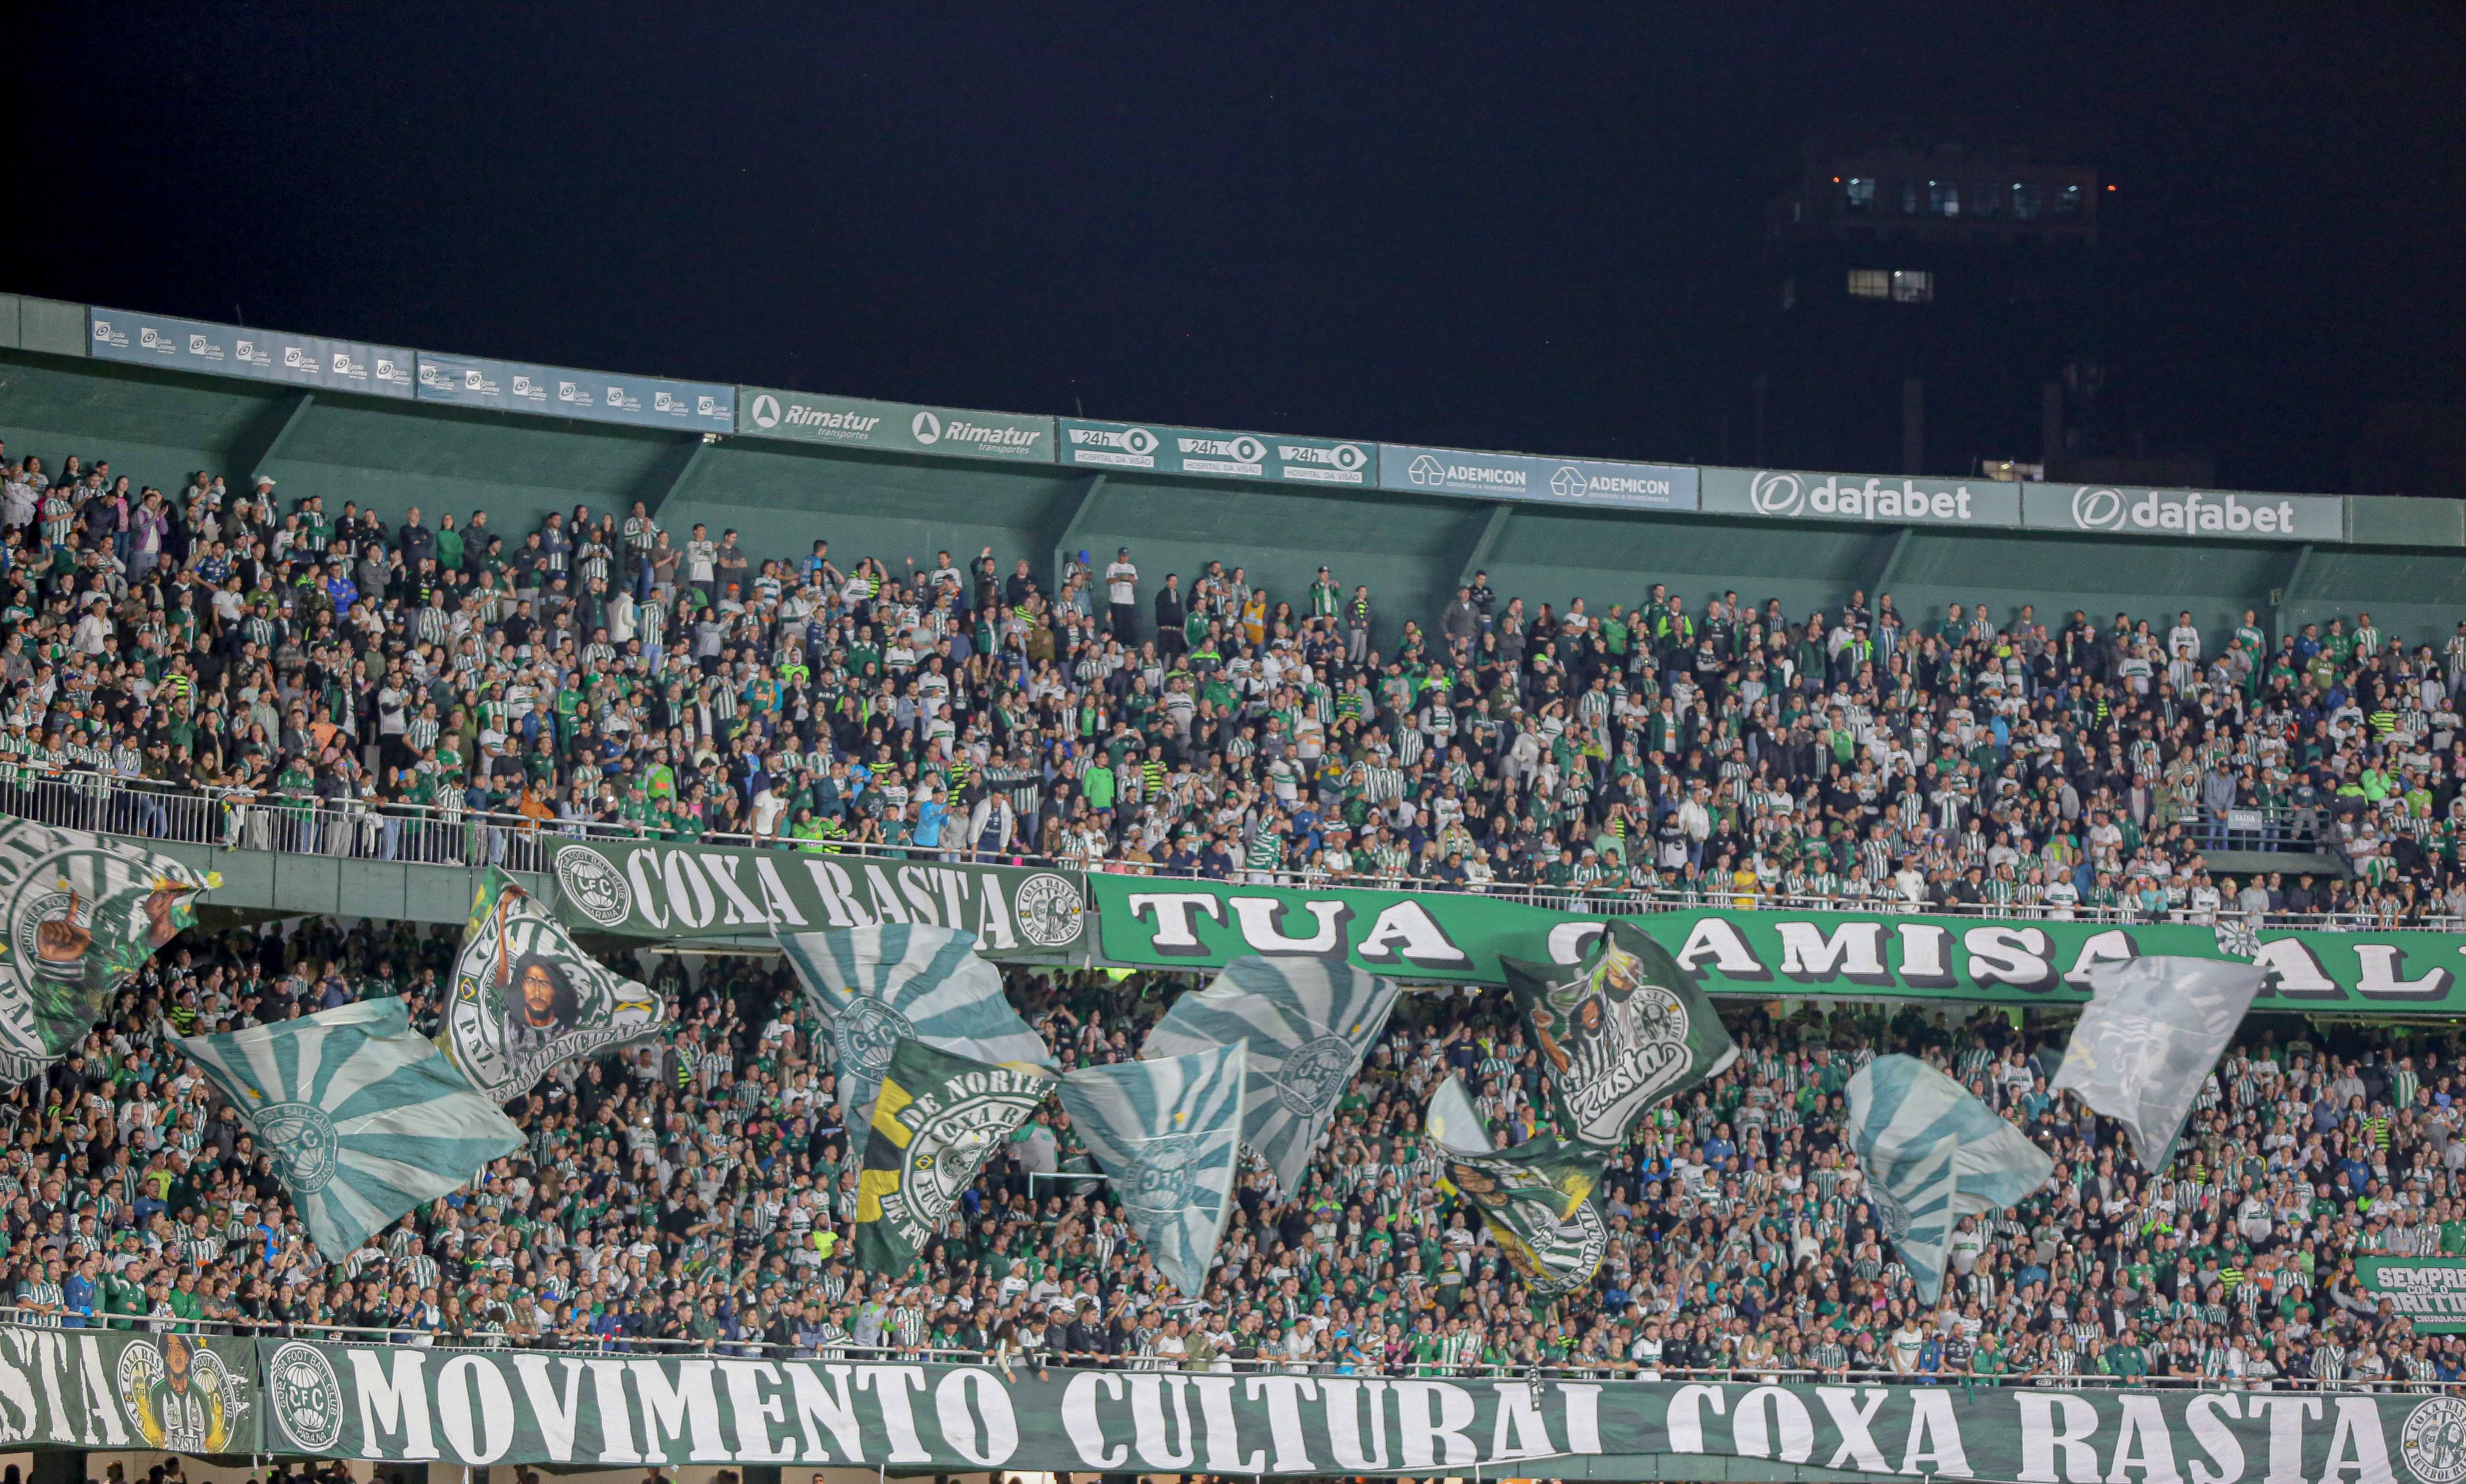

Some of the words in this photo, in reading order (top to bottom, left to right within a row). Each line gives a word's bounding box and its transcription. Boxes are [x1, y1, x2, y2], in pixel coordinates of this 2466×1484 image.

[784, 404, 880, 431] Rimatur
[818, 427, 869, 440] transportes
[945, 422, 1040, 446] Rimatur
[1082, 431, 1110, 445] 24h
[979, 443, 1030, 455] transportes
[1191, 441, 1218, 454] 24h
[1291, 447, 1319, 462] 24h
[1446, 465, 1527, 485] ADEMICON
[1589, 476, 1669, 494] ADEMICON
[1810, 476, 1971, 520] dafabet
[2132, 491, 2293, 535] dafabet
[613, 875, 625, 898] CLUB
[628, 848, 808, 929] COXA
[804, 859, 1020, 950] RASTA
[1128, 892, 1469, 965] TUA
[2253, 937, 2466, 992] AL
[1572, 1043, 1686, 1124] Rasta
[899, 1092, 942, 1130] DE
[943, 1070, 1045, 1103] NORTE
[2406, 1284, 2434, 1295] COM
[2439, 1285, 2449, 1295] O
[196, 1356, 210, 1367] FOOT
[212, 1360, 223, 1386] BALL
[223, 1386, 232, 1419] CLUB
[276, 1359, 288, 1408] CORBA
[287, 1350, 308, 1364] FOOT
[310, 1356, 328, 1381] BALL
[327, 1383, 337, 1416] CLUB
[289, 1385, 324, 1411] CFC
[348, 1348, 1020, 1466] MOVIMENTO
[1666, 1384, 1975, 1477] COXA
[2013, 1390, 2400, 1484] RASTA
